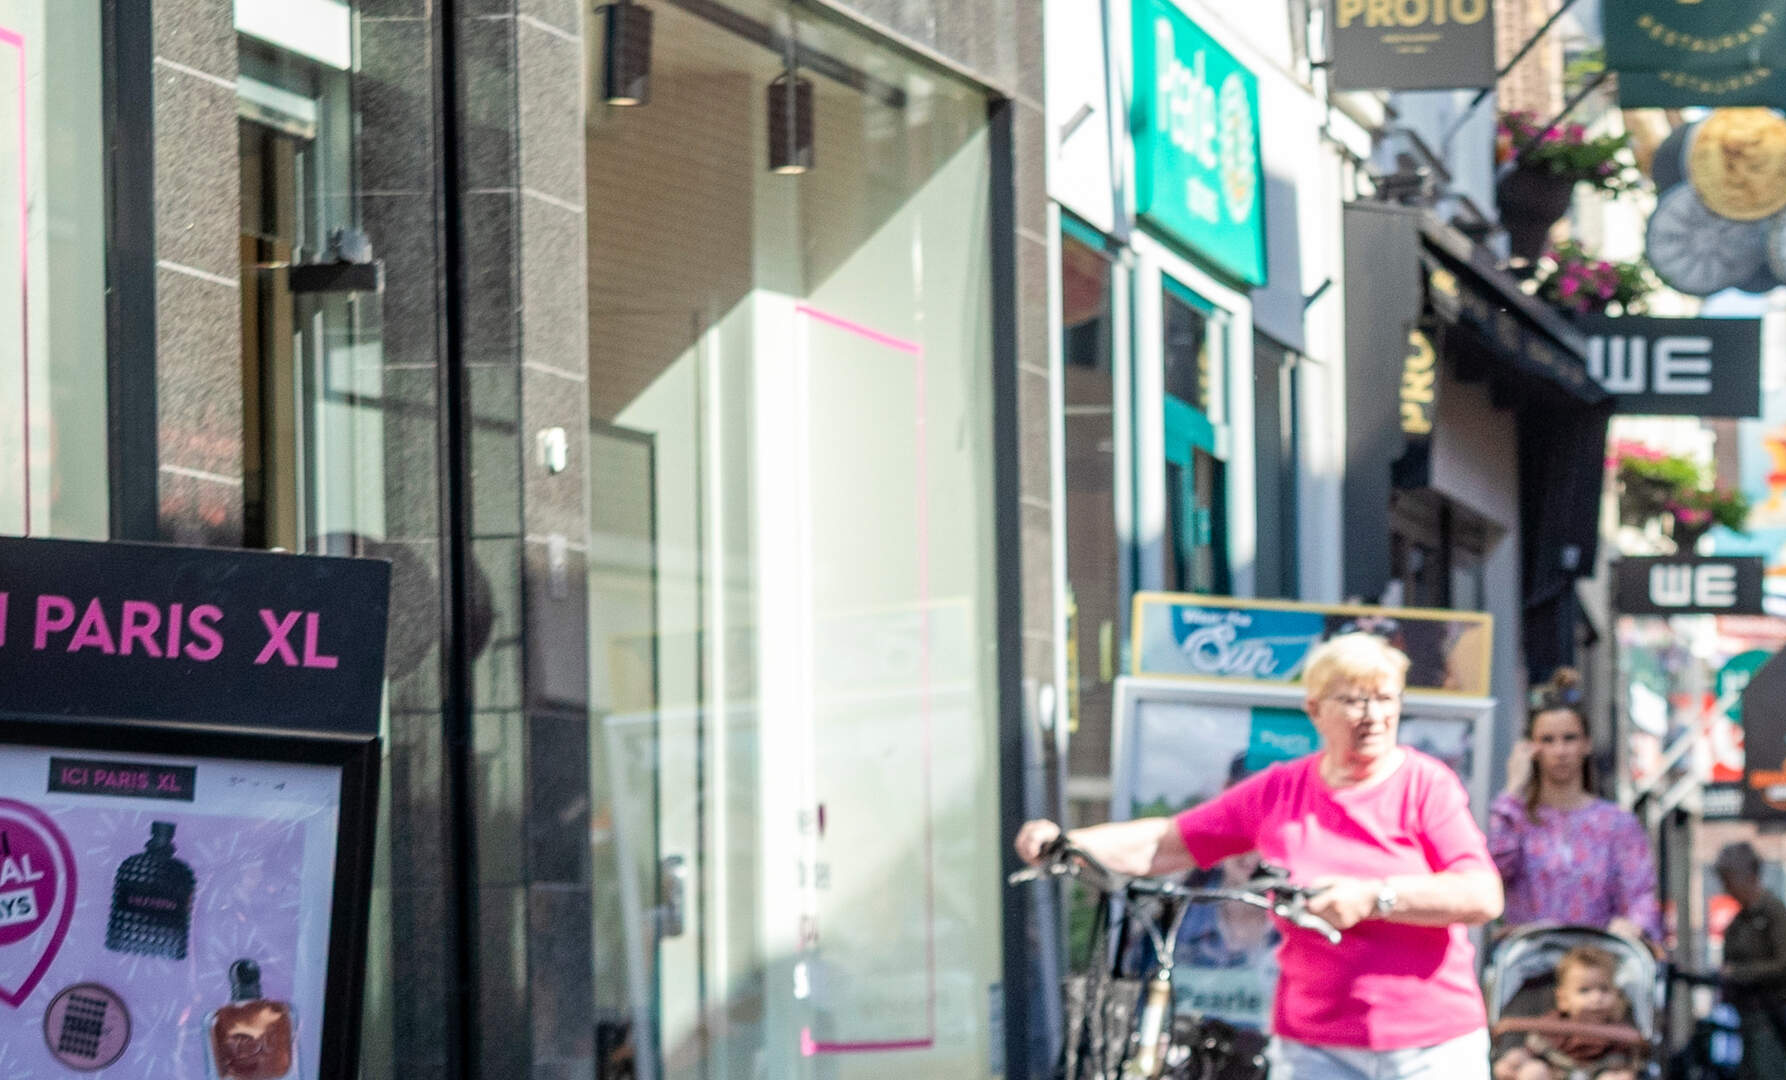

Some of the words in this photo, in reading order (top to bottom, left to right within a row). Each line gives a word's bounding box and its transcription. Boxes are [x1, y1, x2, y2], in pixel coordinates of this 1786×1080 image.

[1588, 334, 1713, 394] WE
[1650, 563, 1737, 608] WE
[33, 594, 225, 662] PARIS
[253, 608, 339, 669] XL
[61, 767, 89, 785] ICI
[93, 769, 149, 790] PARIS
[155, 773, 182, 793] XL
